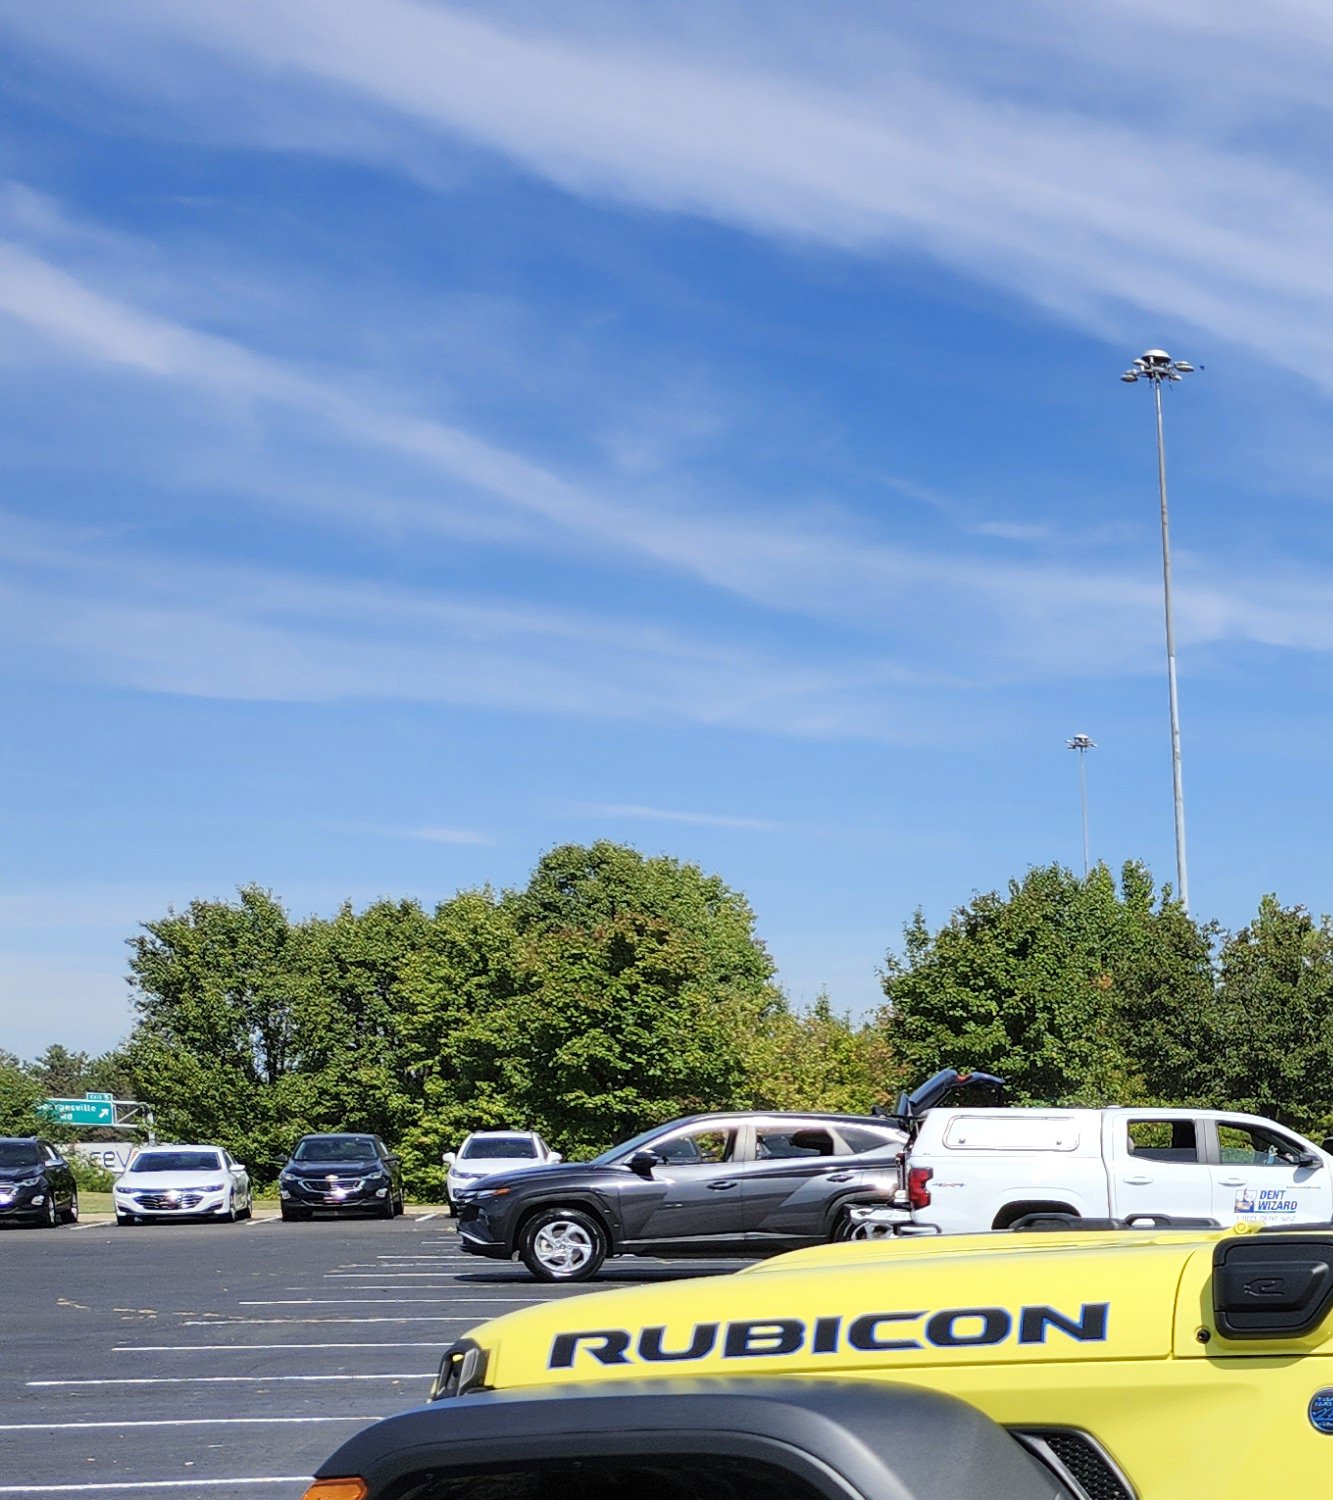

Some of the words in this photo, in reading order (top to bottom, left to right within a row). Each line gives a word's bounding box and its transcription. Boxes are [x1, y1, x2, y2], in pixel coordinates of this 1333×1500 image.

[1259, 1190, 1286, 1200] DENT
[1257, 1200, 1298, 1211] WIZARD
[547, 1302, 1110, 1369] RUBICON
